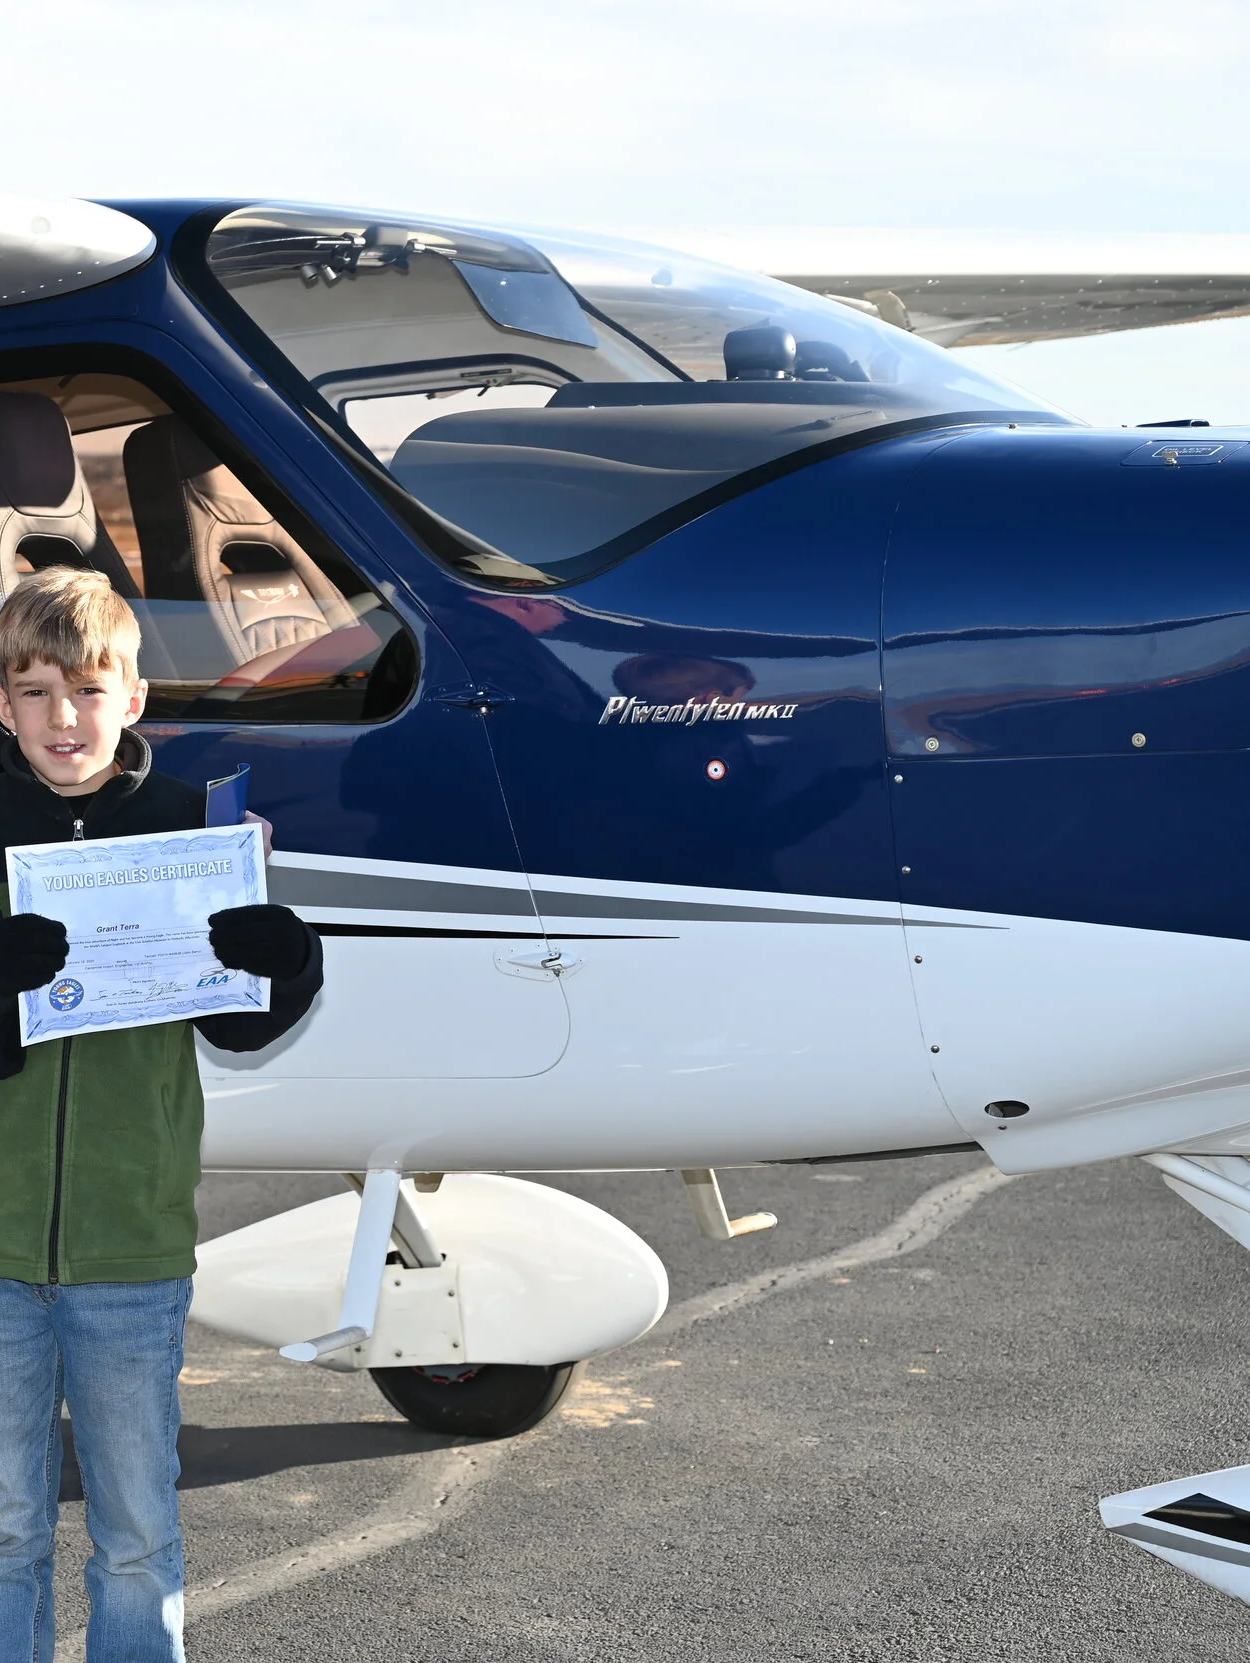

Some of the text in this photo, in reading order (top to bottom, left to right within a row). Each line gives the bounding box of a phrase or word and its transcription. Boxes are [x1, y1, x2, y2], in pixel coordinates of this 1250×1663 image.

[43, 859, 232, 892] YOUNG EAGLES CERTIFICATE
[96, 925, 118, 933] Grant
[196, 975, 229, 988] EAA
